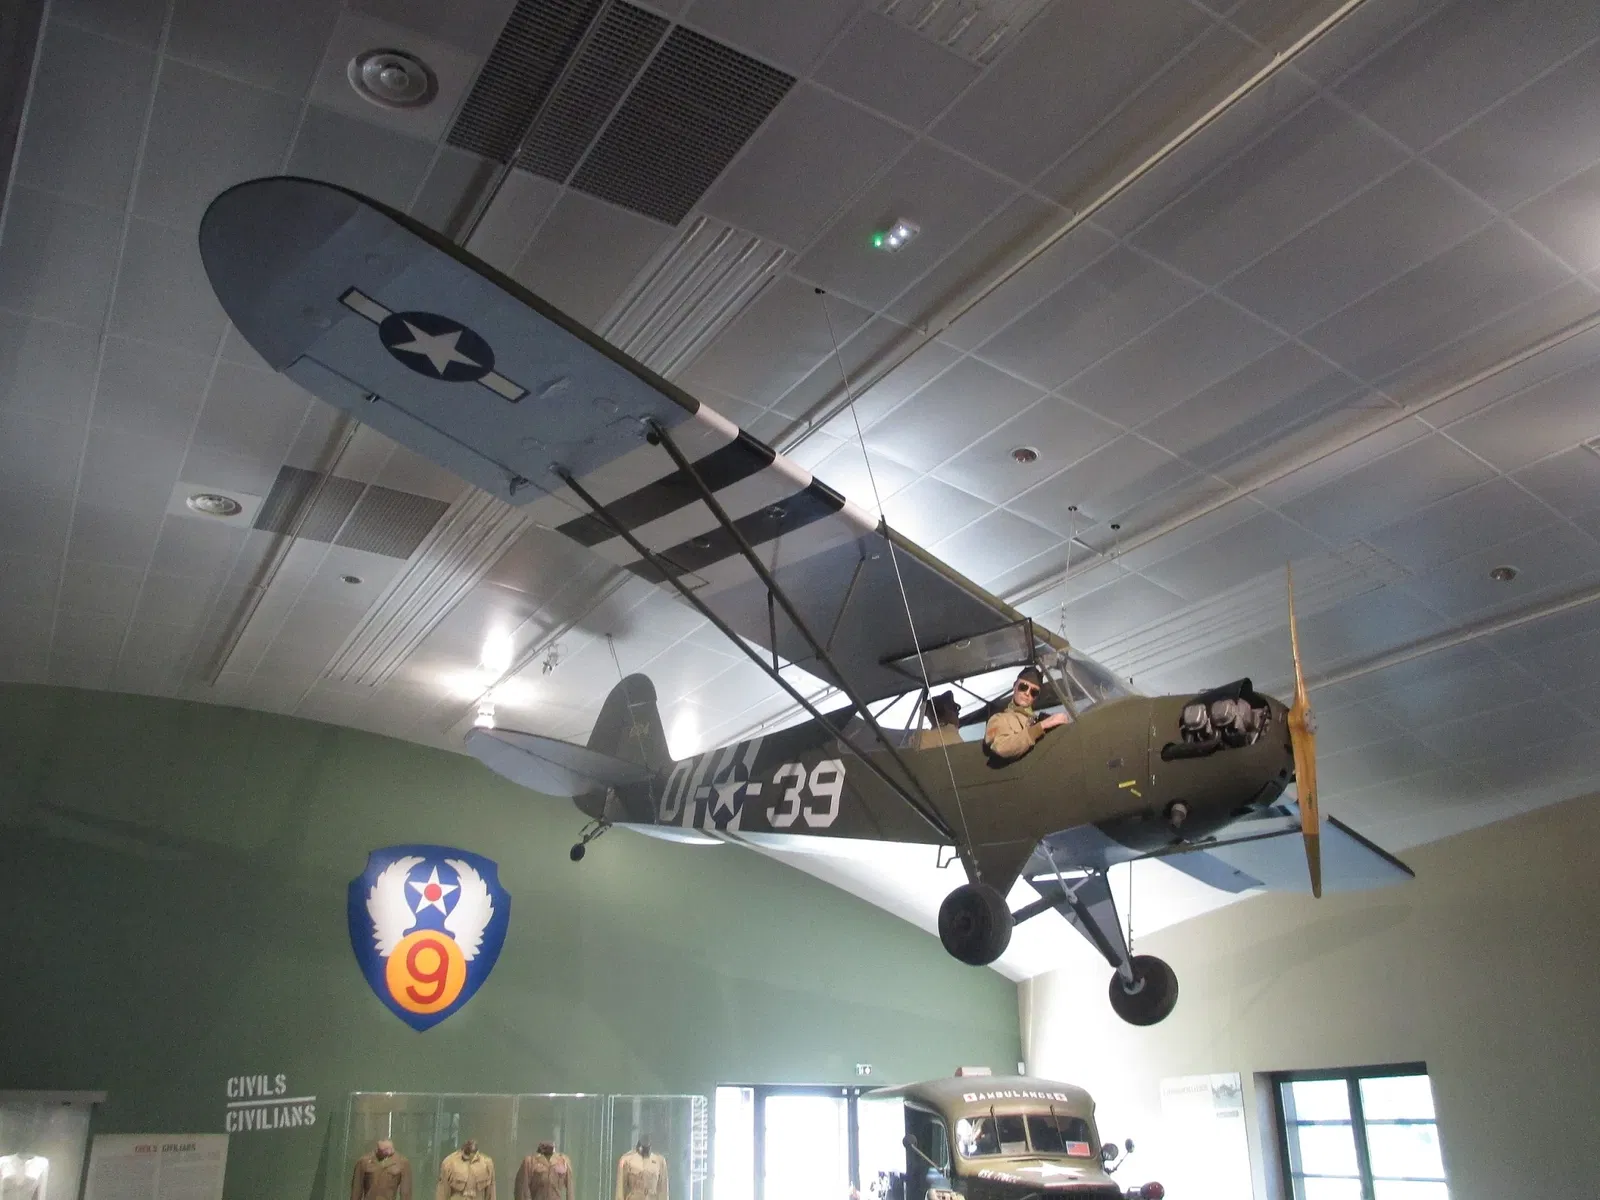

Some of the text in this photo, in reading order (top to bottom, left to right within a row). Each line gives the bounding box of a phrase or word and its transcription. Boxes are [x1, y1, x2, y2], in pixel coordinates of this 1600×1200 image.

[766, 758, 846, 828] 39
[405, 938, 449, 1005] 9
[227, 1073, 287, 1097] CIVILS
[979, 1090, 1055, 1101] AMBULANCE
[226, 1104, 316, 1132] CIVILIANS
